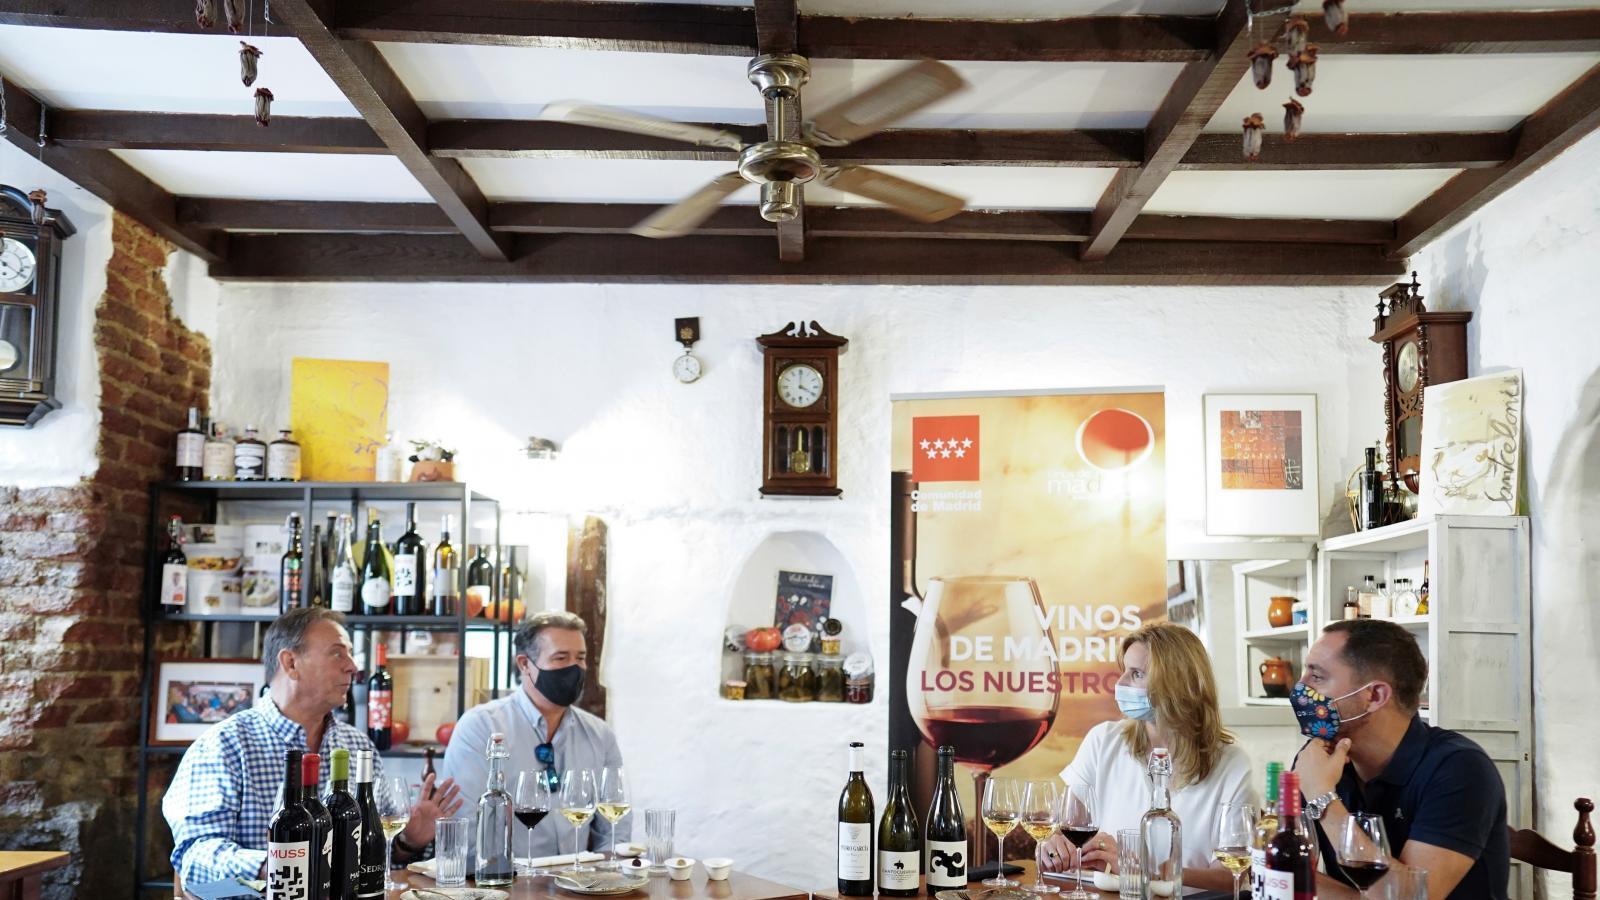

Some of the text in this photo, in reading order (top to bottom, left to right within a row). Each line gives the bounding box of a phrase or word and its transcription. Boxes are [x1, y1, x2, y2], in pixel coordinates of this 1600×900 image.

[911, 489, 982, 501] Comunidad
[911, 500, 982, 512] de Madrid
[1033, 604, 1142, 631] VINOS
[950, 635, 1124, 663] DE MADRI
[921, 669, 1120, 694] LOS NUESTRO
[270, 848, 306, 859] MUSS
